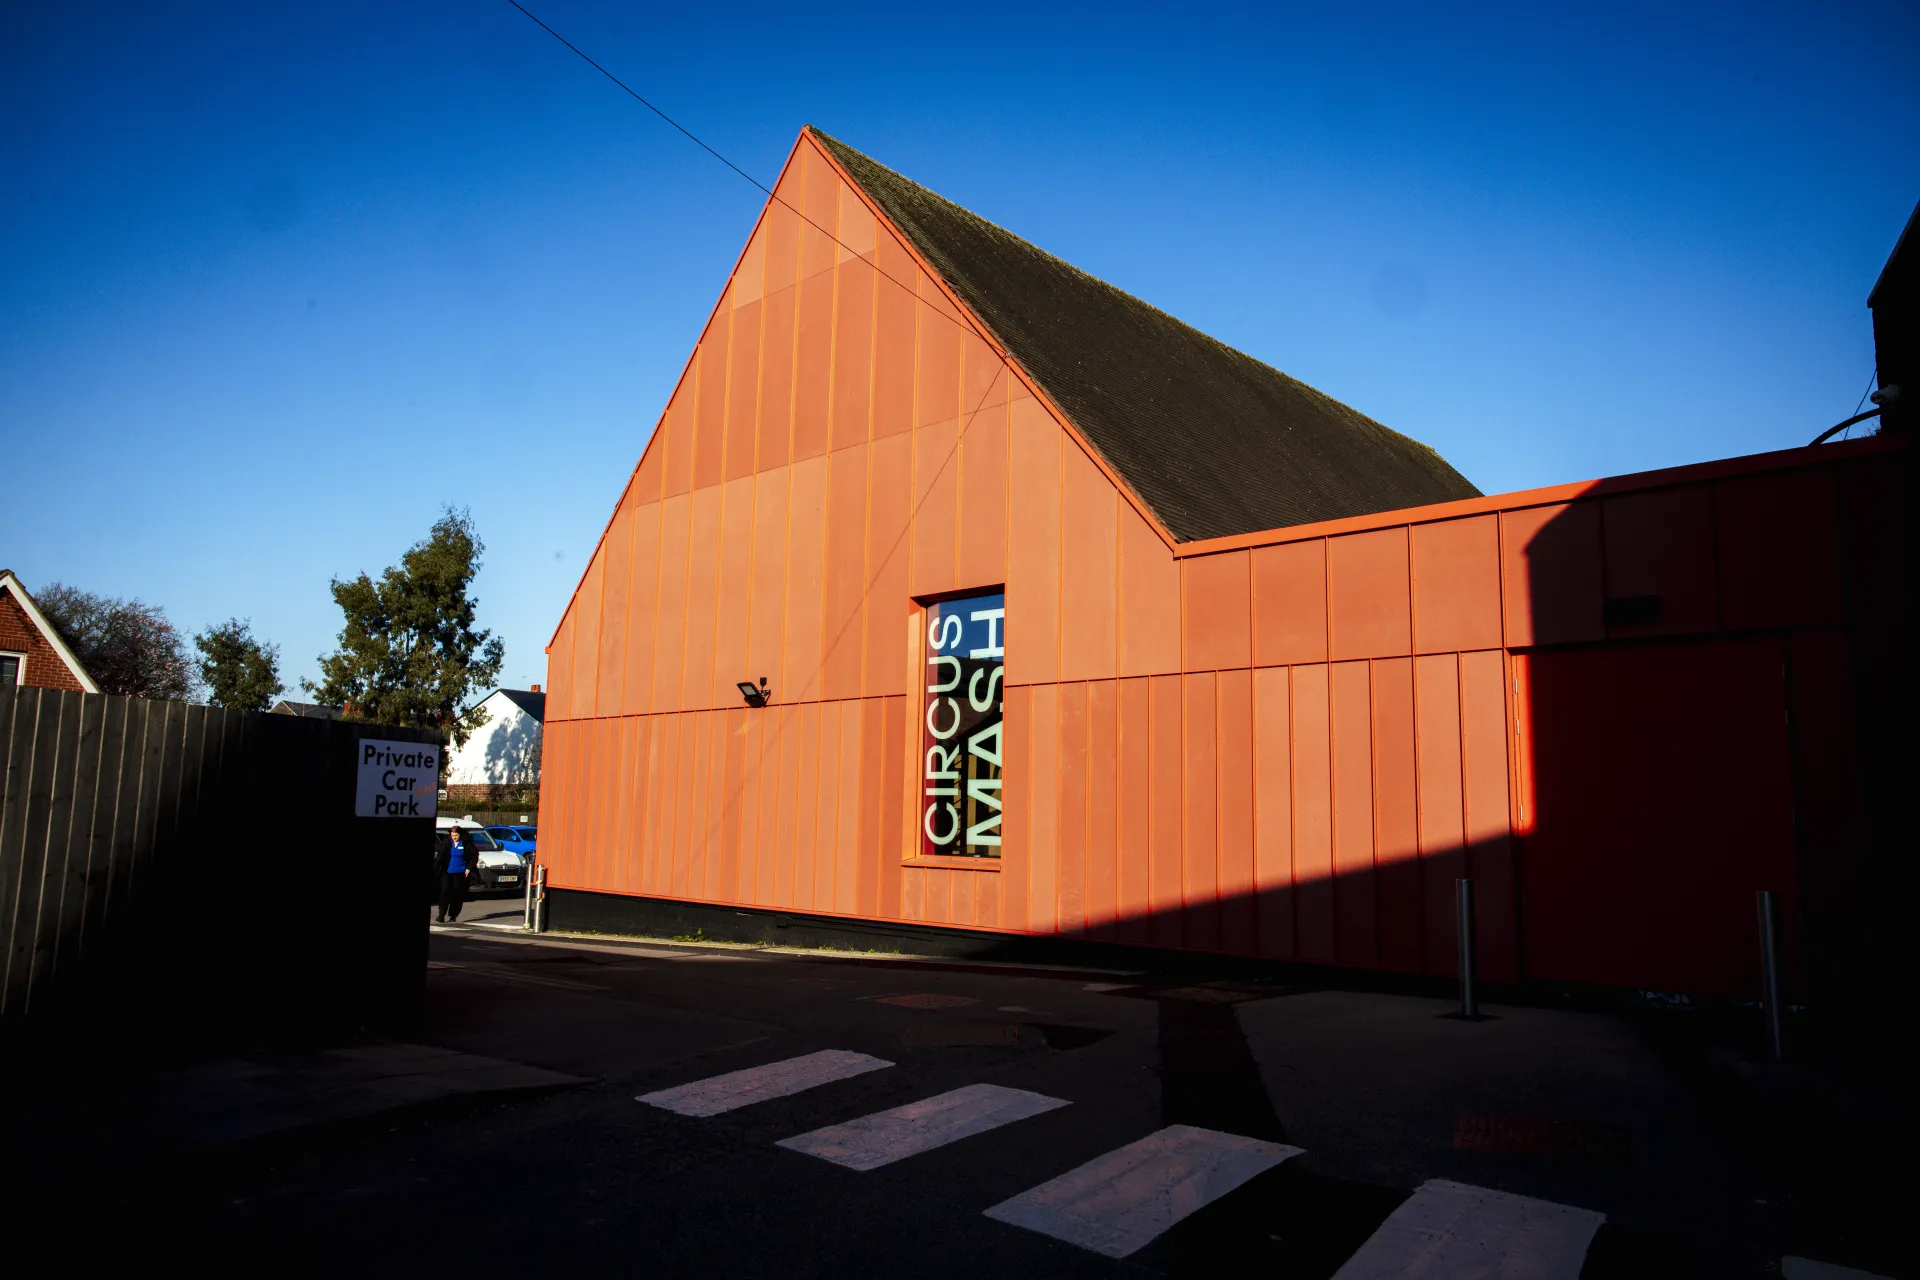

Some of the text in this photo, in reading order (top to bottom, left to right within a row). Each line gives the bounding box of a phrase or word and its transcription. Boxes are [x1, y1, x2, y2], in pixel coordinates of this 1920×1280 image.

[924, 614, 962, 845] CIRCUS
[966, 607, 1005, 846] MASH
[363, 744, 434, 769] Private
[382, 769, 416, 791] Car
[374, 794, 419, 816] Park
